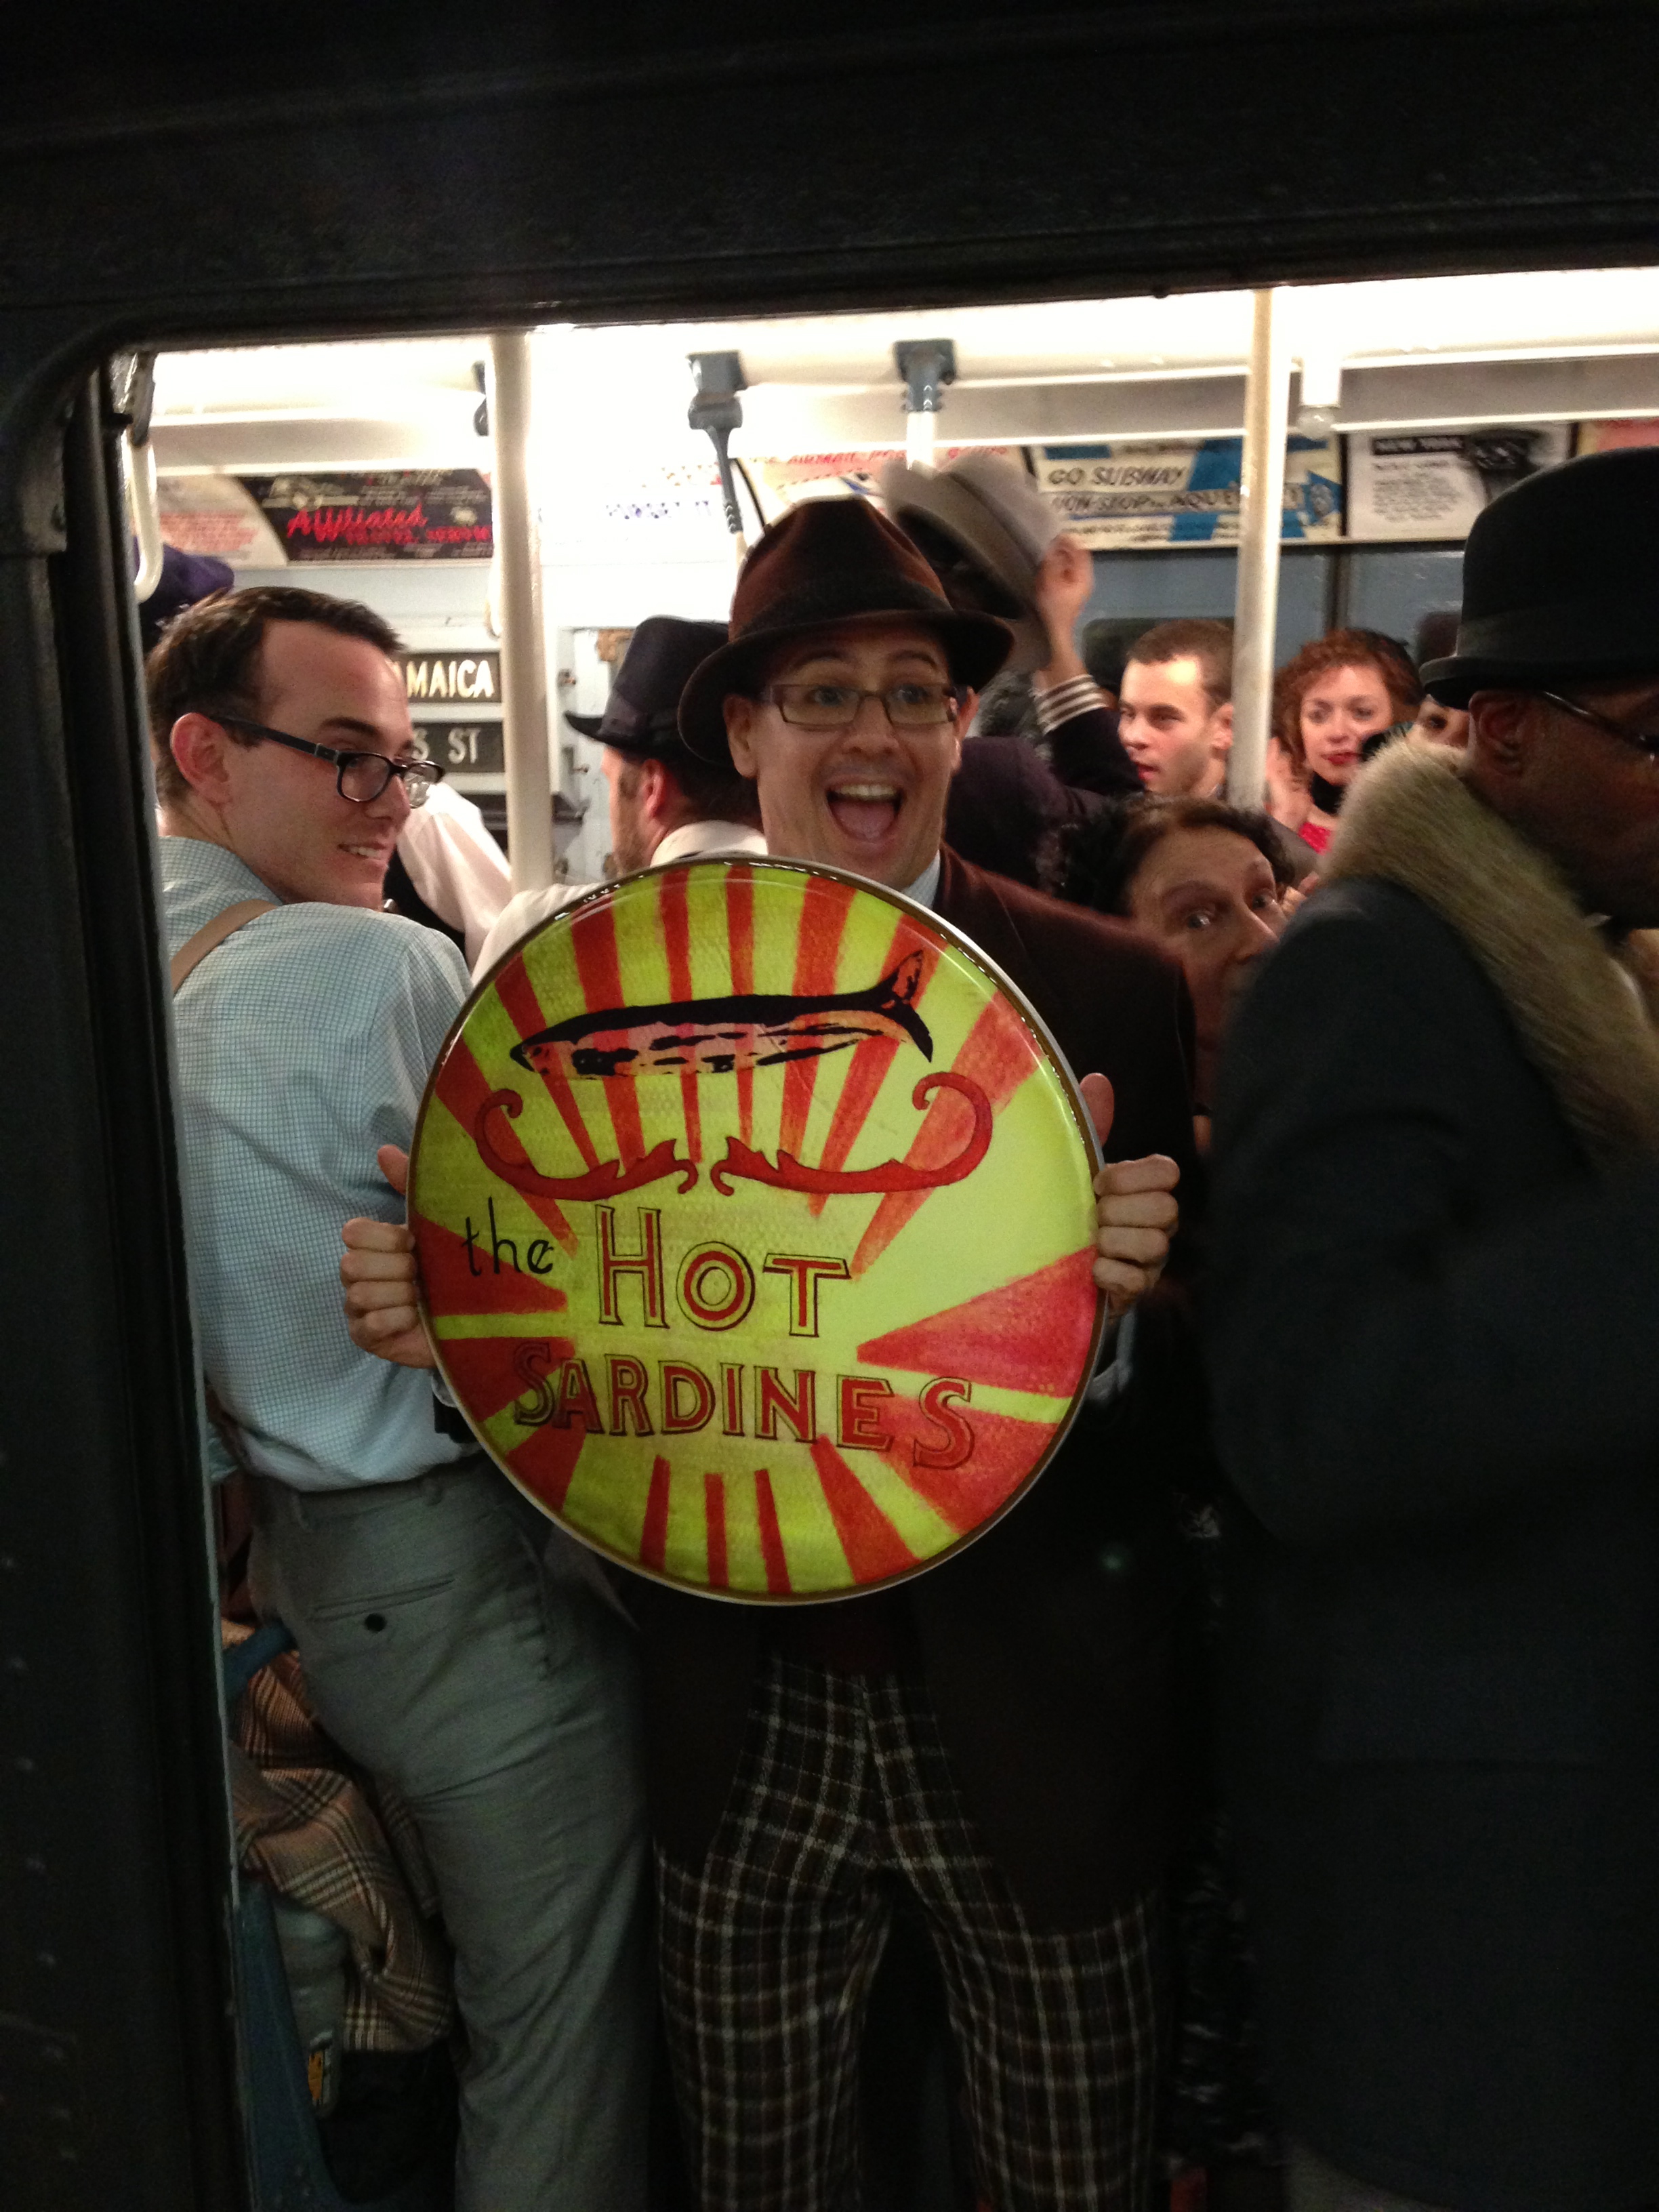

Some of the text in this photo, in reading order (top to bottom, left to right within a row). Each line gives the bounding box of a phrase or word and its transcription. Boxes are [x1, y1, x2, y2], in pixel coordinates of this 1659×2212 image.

[1047, 465, 1187, 486] GO SUBWAY
[447, 726, 482, 764] ST
[462, 1196, 852, 1338] the HOT
[513, 1340, 975, 1471] SARDINES
